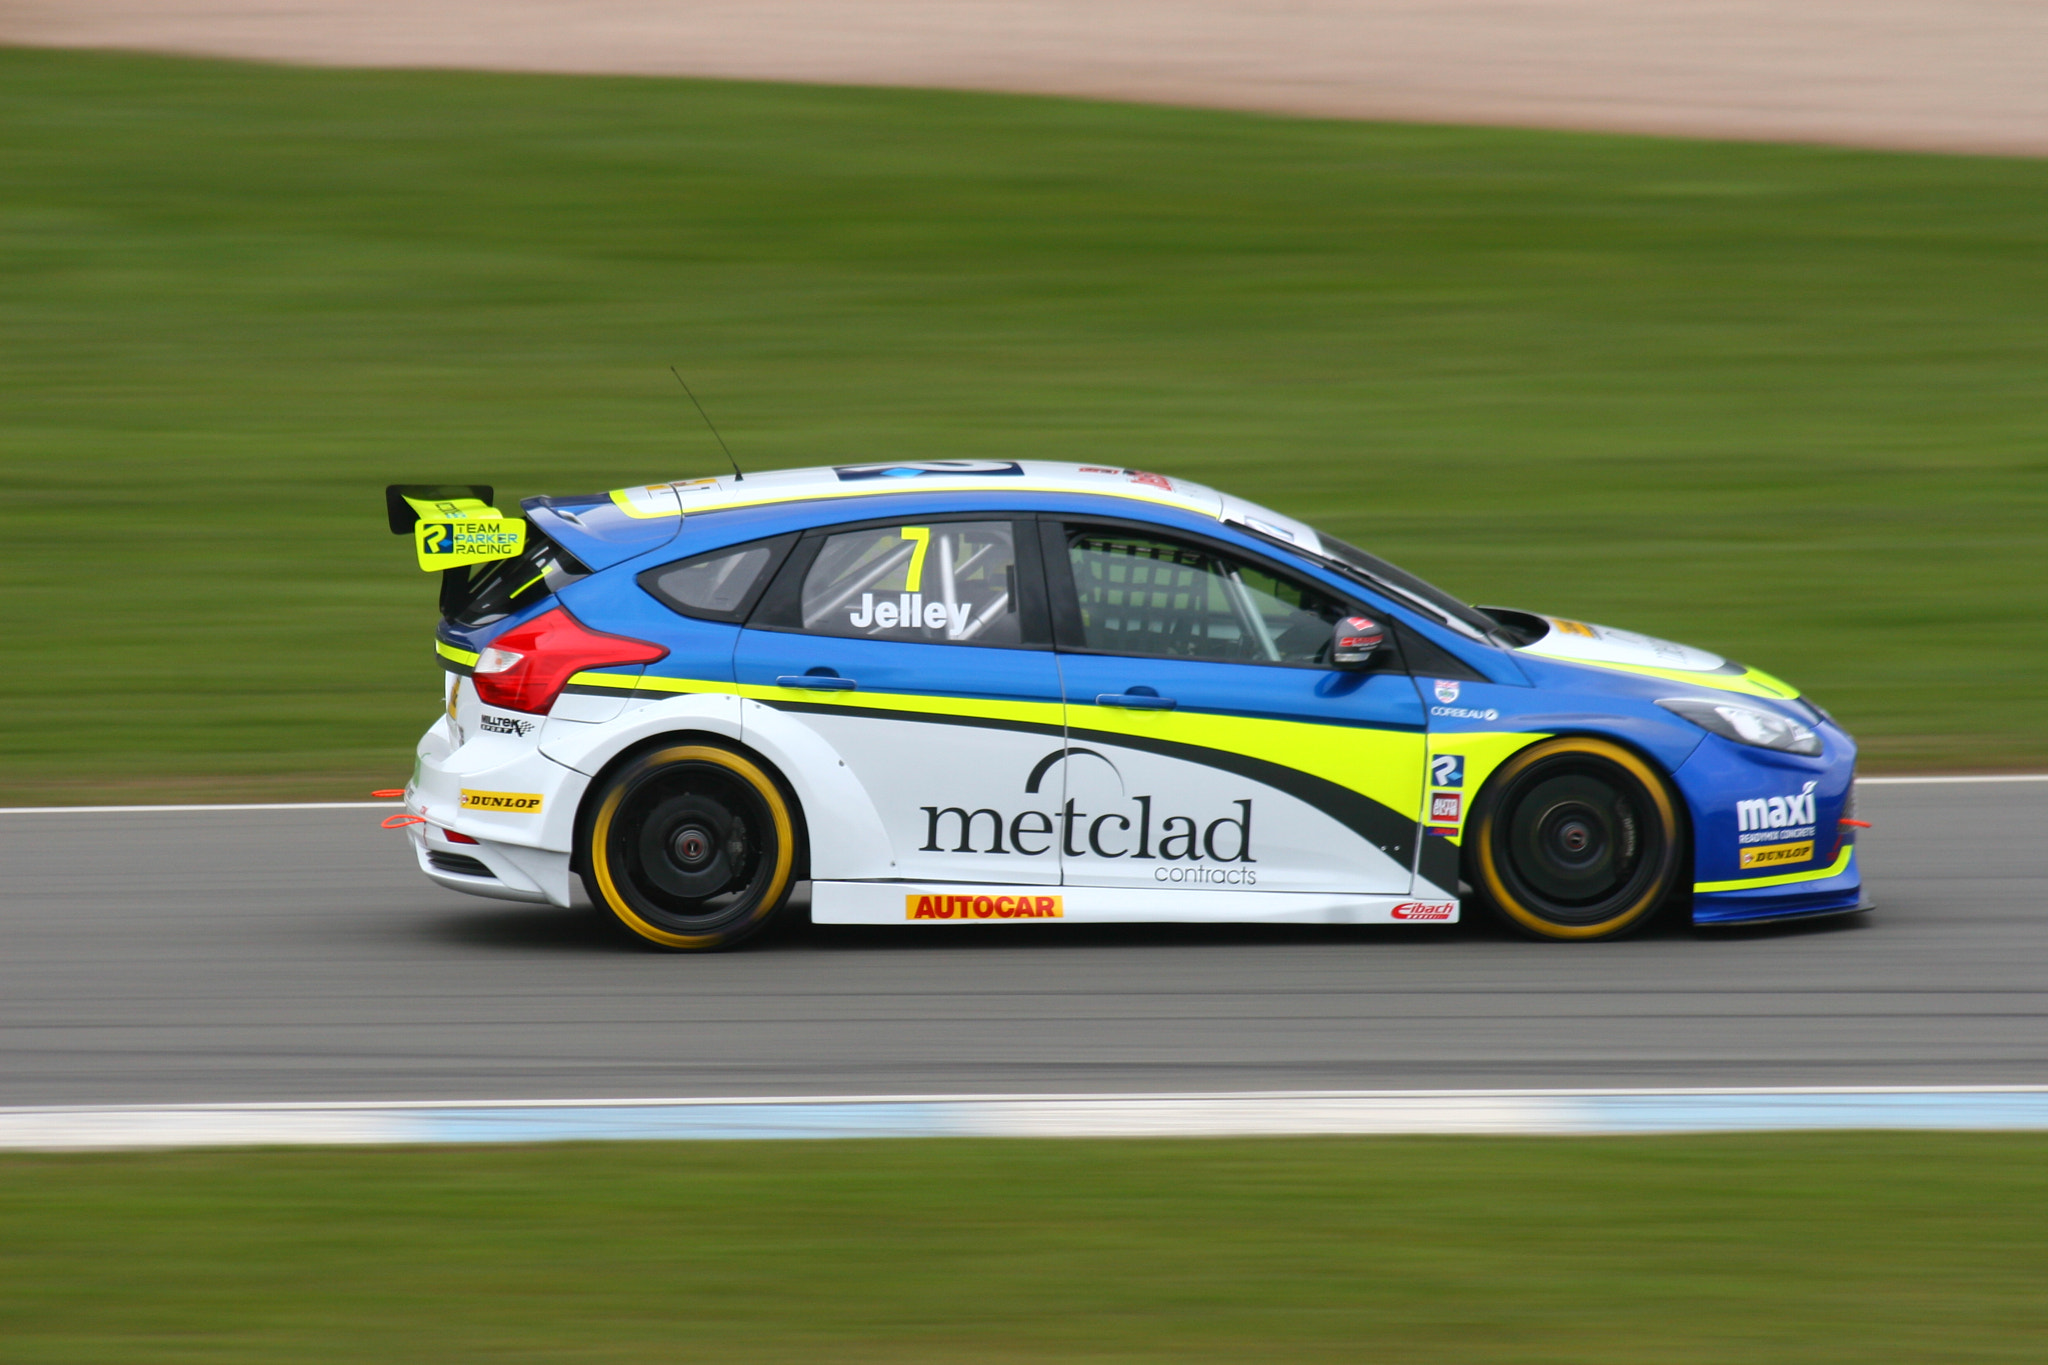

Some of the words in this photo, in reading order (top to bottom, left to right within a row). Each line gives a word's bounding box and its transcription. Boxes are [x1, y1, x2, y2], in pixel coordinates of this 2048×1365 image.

[456, 523, 500, 533] TEAM
[456, 533, 518, 544] PARKER
[456, 544, 512, 555] RACING
[901, 527, 930, 592] 7
[850, 593, 972, 636] Jelley
[471, 795, 540, 808] DUNLOP
[918, 795, 1257, 863] metclad
[1780, 826, 1816, 839] CONCRETE
[1756, 847, 1810, 862] DUNLOP
[1154, 864, 1257, 885] contracts
[914, 896, 1056, 919] AUTOCAR
[1390, 902, 1455, 920] Eibach
